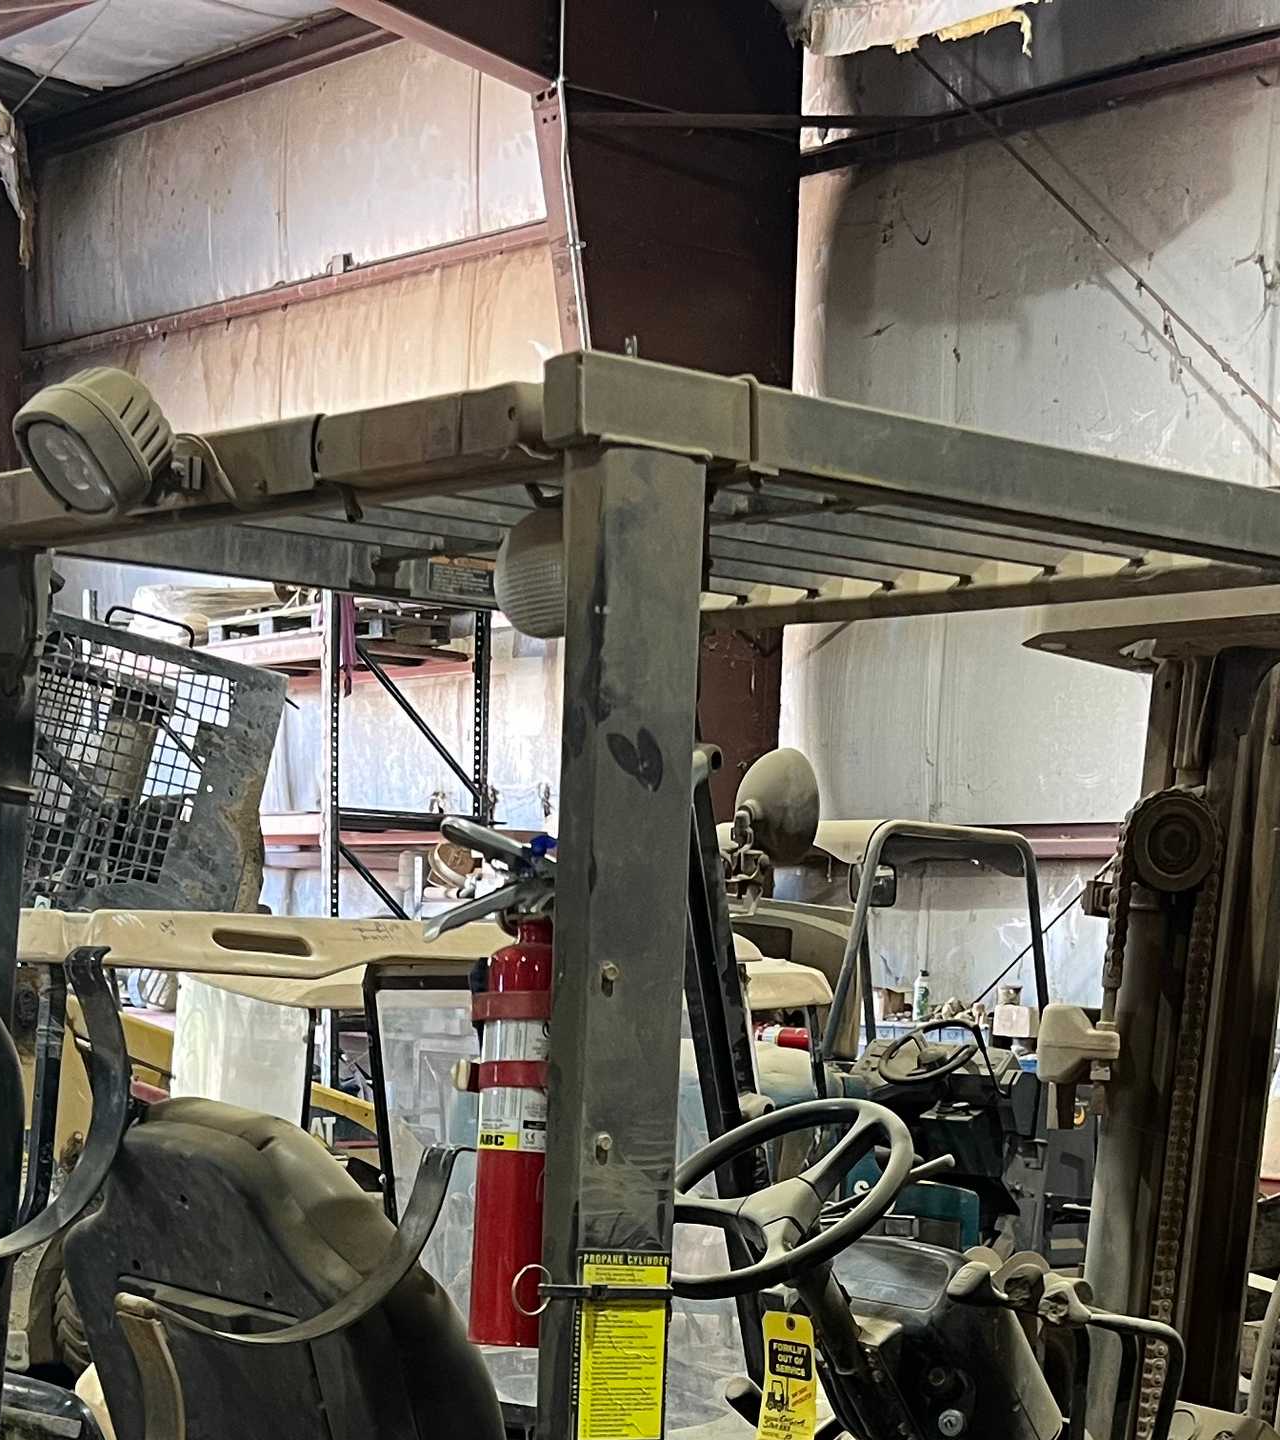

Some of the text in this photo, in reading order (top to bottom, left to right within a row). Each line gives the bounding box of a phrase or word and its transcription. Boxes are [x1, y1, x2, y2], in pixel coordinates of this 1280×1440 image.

[310, 1116, 336, 1148] AT
[480, 1133, 505, 1147] ABC
[583, 1253, 670, 1266] PROPANE CYLINDER
[773, 1342, 808, 1356] FORKLIFT
[777, 1353, 804, 1366] OUT OF
[775, 1363, 806, 1377] SERVICE
